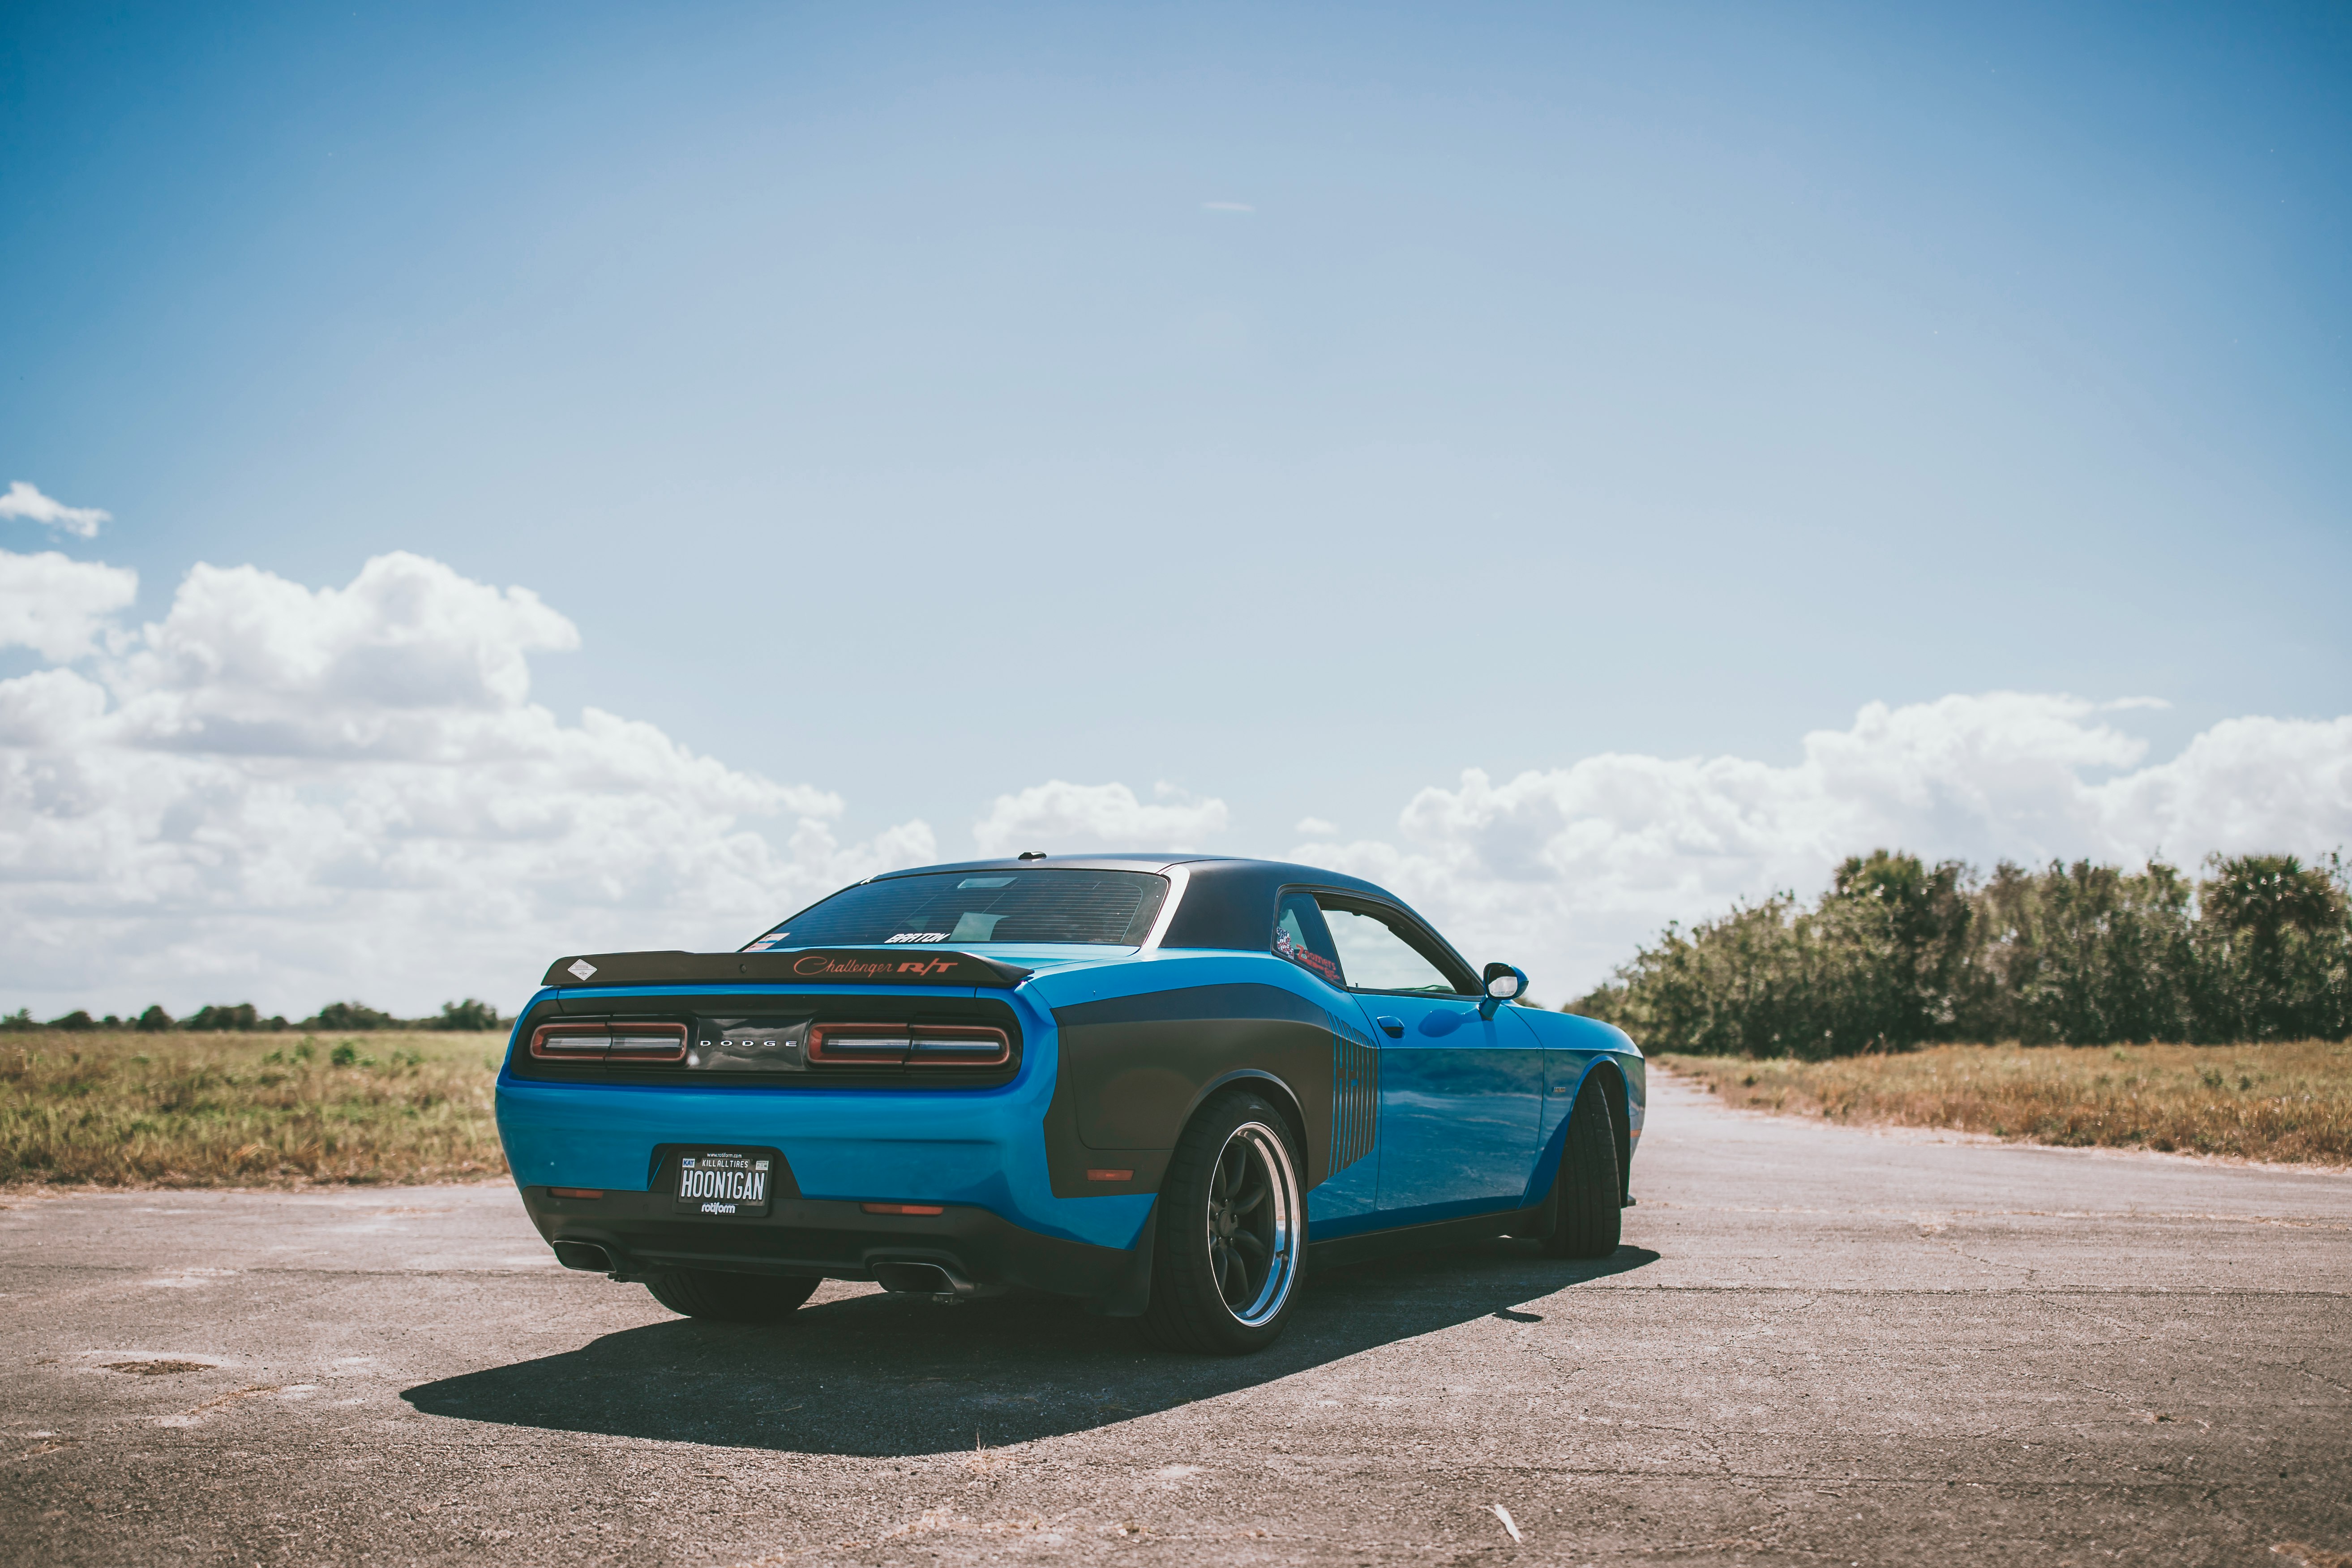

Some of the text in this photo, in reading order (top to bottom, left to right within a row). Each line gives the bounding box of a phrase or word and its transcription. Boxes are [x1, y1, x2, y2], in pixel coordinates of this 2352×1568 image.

[884, 933, 951, 943] BARTON
[794, 956, 958, 977] Challenger R/T
[730, 1160, 749, 1168] TIRES
[701, 1202, 736, 1215] rotiform
